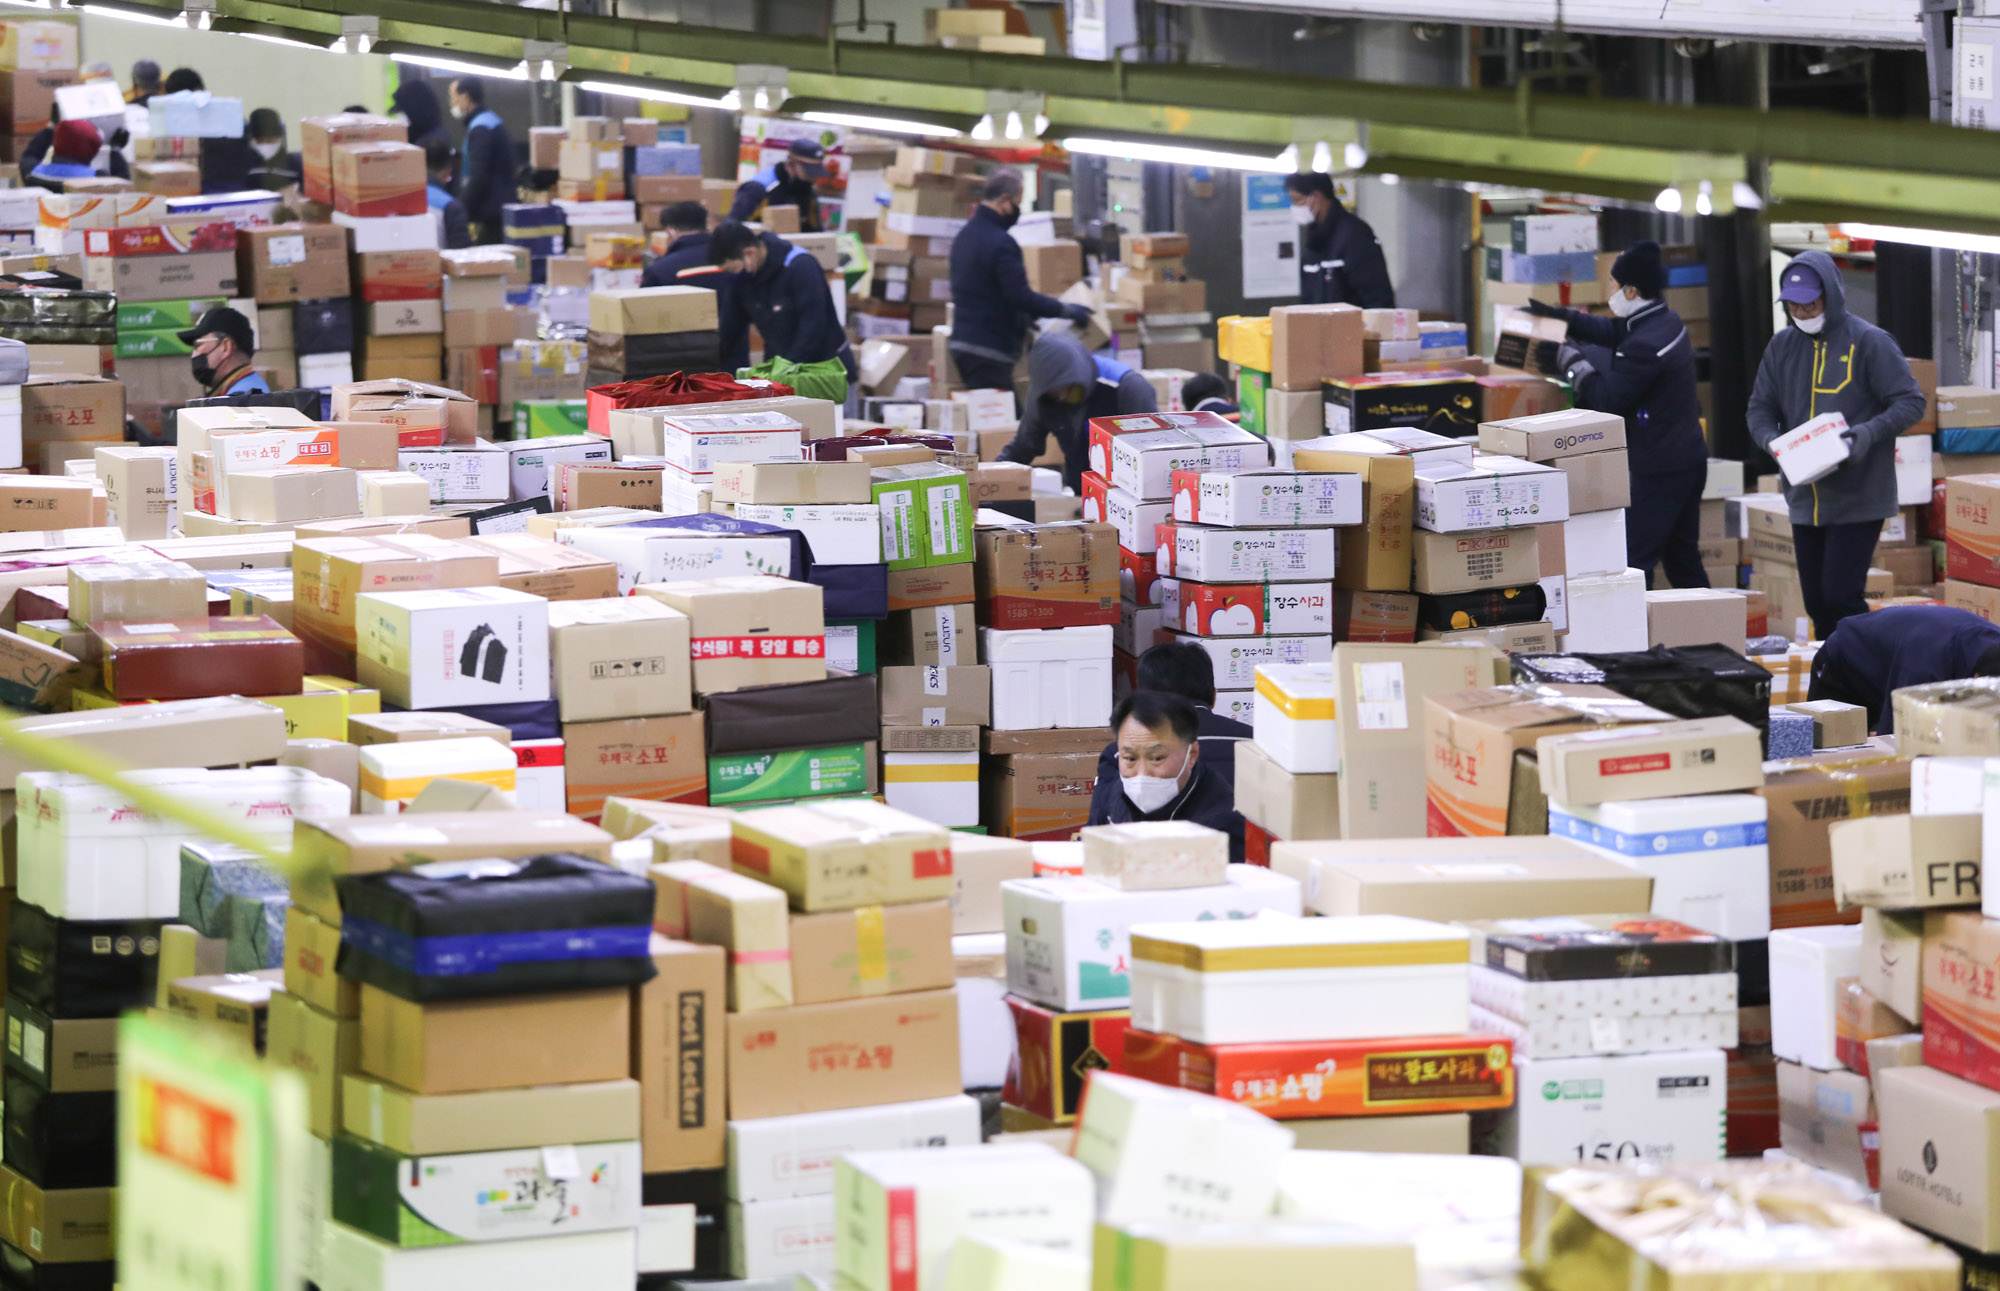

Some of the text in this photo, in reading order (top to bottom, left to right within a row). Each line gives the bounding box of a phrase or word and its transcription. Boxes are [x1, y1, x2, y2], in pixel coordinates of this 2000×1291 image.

[66, 409, 95, 426] 소포
[1577, 431, 1604, 443] OPTICS
[260, 445, 281, 459] 쇼핑
[420, 462, 451, 471] 장수사과
[1181, 458, 1211, 468] 장수사과
[1273, 485, 1304, 494] 장수사과
[1972, 507, 1988, 525] 소포
[1244, 540, 1275, 550] 장수사과
[1059, 565, 1089, 583] 소포
[1274, 595, 1324, 609] 장수사과
[1007, 607, 1054, 618] 1588-1300
[760, 639, 787, 656] 당일
[793, 639, 820, 655] 배송
[1242, 648, 1273, 657] 장수사과
[598, 747, 669, 766] 우체국 소포
[743, 762, 765, 776] 쇼핑
[1454, 752, 1479, 786] 소포
[1967, 959, 1997, 1001] 소포
[855, 1045, 894, 1070] 쇼핑
[1232, 1072, 1323, 1102] 우체국 쇼핑
